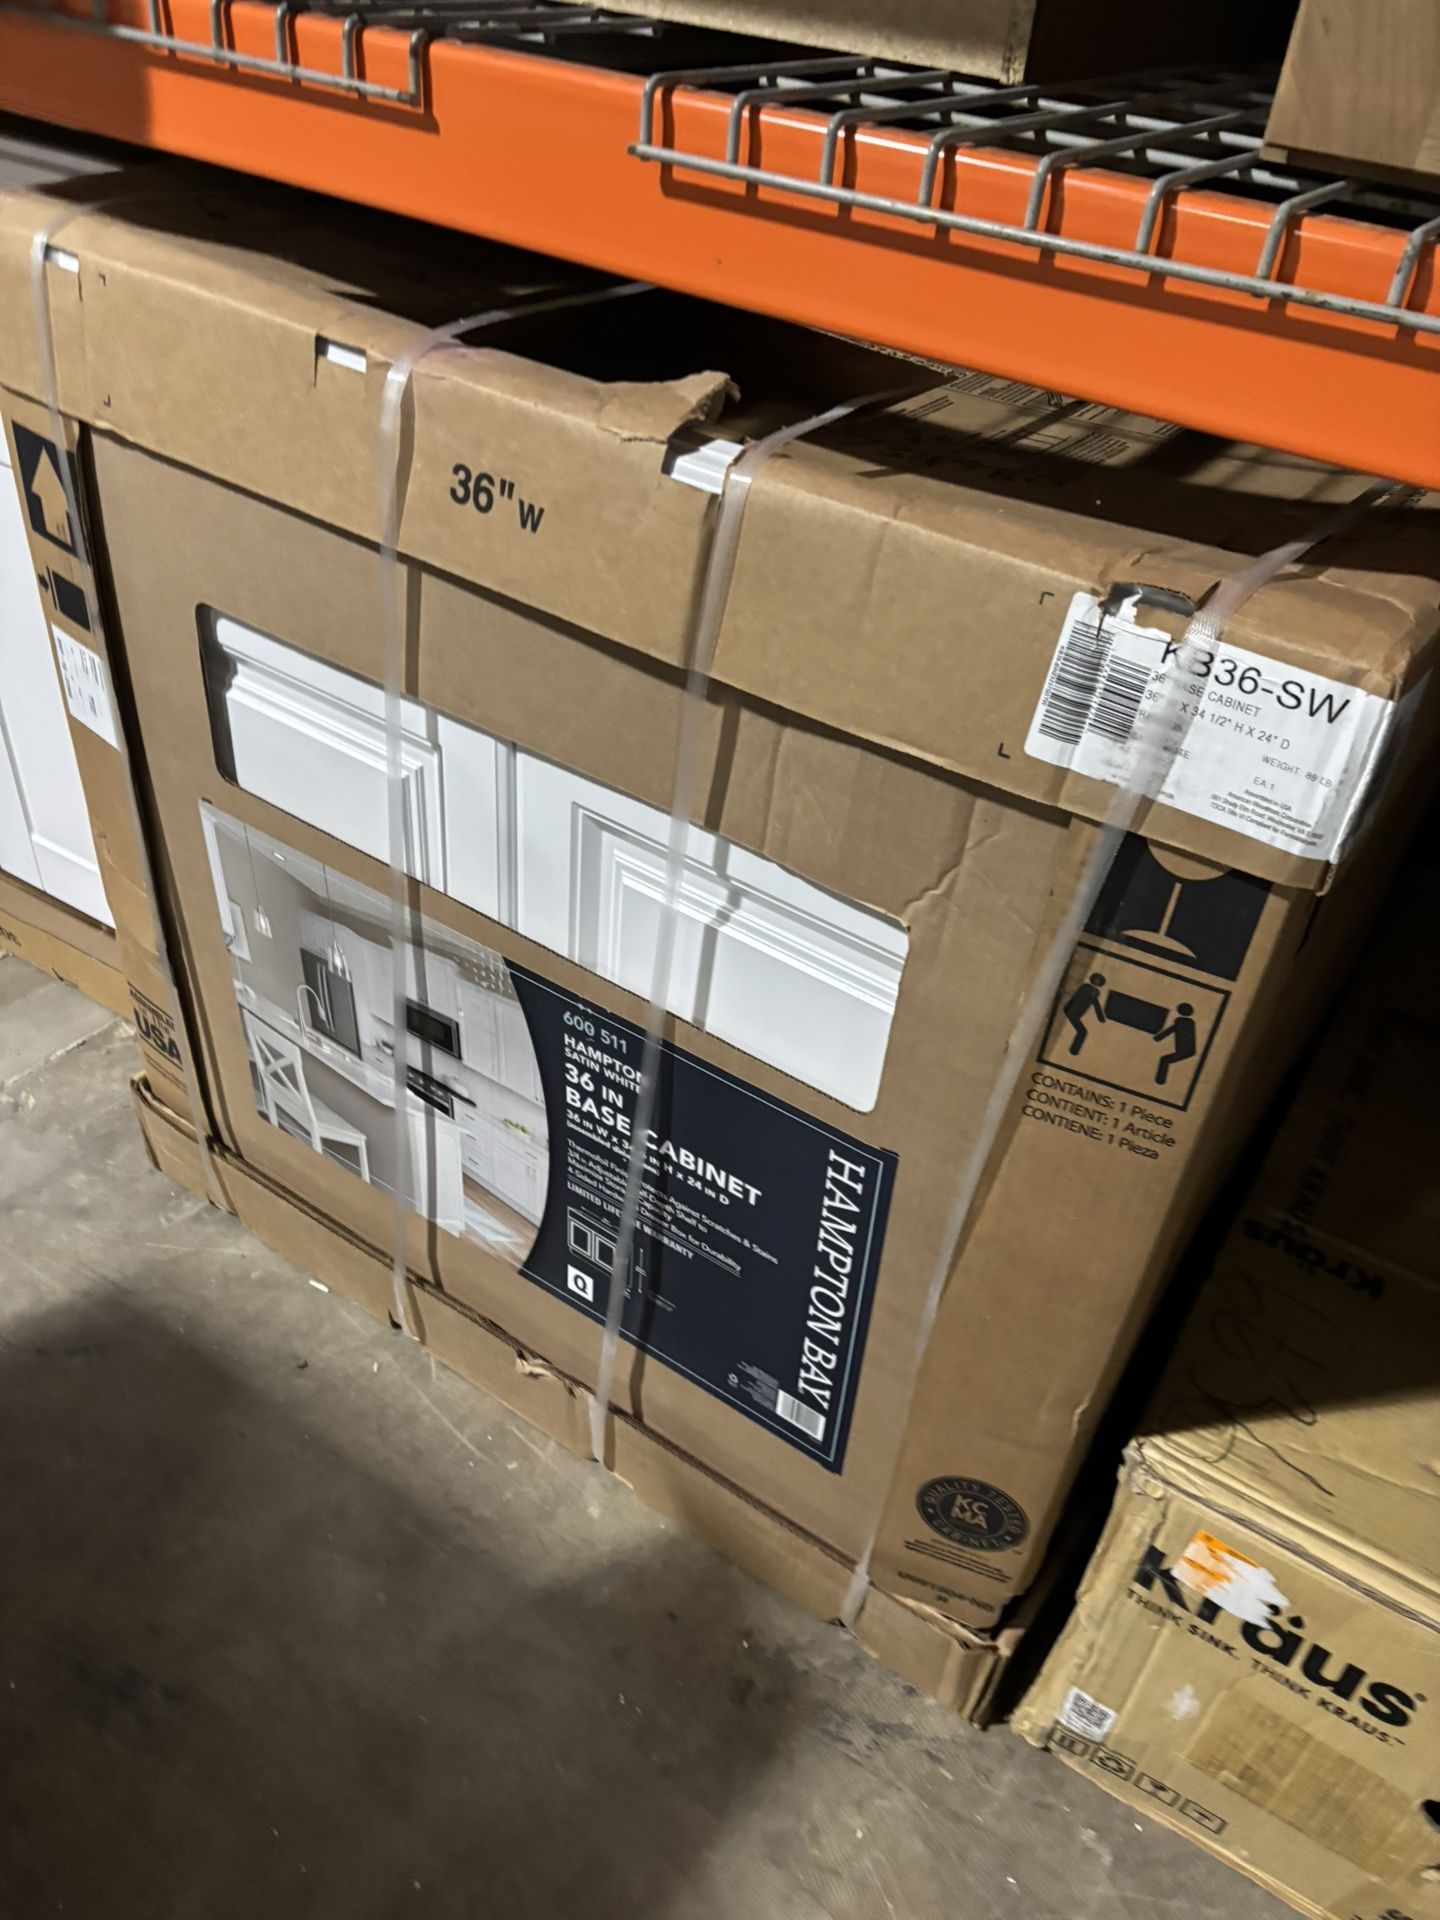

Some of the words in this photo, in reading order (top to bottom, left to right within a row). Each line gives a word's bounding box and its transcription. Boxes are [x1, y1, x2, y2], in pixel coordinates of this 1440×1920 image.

[449, 463, 515, 514] 36"
[1160, 640, 1351, 725] KB36-SW
[1207, 690, 1262, 718] CABINET
[1180, 701, 1189, 714] X
[1191, 707, 1206, 720] 34
[1210, 712, 1232, 727] 1/2"
[1233, 723, 1245, 734] H
[1245, 725, 1256, 738] X
[1257, 729, 1279, 744] 24"
[1280, 738, 1291, 750] D
[1262, 754, 1301, 776] WEIGHT
[133, 1005, 184, 1067] USA
[563, 1010, 596, 1037] 600
[600, 1028, 627, 1054] 511
[564, 1046, 600, 1073] SATIN
[602, 1066, 641, 1094] WHITE
[564, 1062, 596, 1092] 36
[601, 1084, 624, 1109] IN
[1026, 1088, 1109, 1126] CONTIENT:
[1112, 1117, 1119, 1129] 1
[1123, 1121, 1177, 1147] Article
[1031, 1071, 1115, 1109] CONTAINS:
[1119, 1101, 1127, 1113] 1
[1131, 1105, 1174, 1129] Piece
[565, 1085, 631, 1137] BASE
[643, 1129, 762, 1207] CABINET
[566, 1108, 581, 1123] 36
[582, 1119, 594, 1131] IN
[596, 1123, 609, 1138] W
[649, 1155, 660, 1168] IN
[663, 1162, 673, 1175] H
[676, 1171, 684, 1181] x
[686, 1175, 703, 1191] 24
[704, 1186, 717, 1199] IN
[718, 1192, 730, 1206] D
[1022, 1104, 1103, 1142] CONTIENE:
[1107, 1133, 1115, 1145] 1
[1118, 1136, 1160, 1160] Pieza
[566, 1180, 602, 1206] LIMITED
[642, 1223, 694, 1260] WARRANTY
[675, 1209, 697, 1227] Shelf
[701, 1213, 742, 1243] Scratches
[751, 1242, 779, 1265] Stains
[670, 1223, 687, 1240] Box
[687, 1234, 700, 1247] for
[701, 1241, 742, 1272] Durability
[805, 1148, 866, 1347] HAMPTON
[797, 1336, 838, 1411] BAY
[1127, 1587, 1184, 1627] THINK
[1251, 1656, 1312, 1700] THINK
